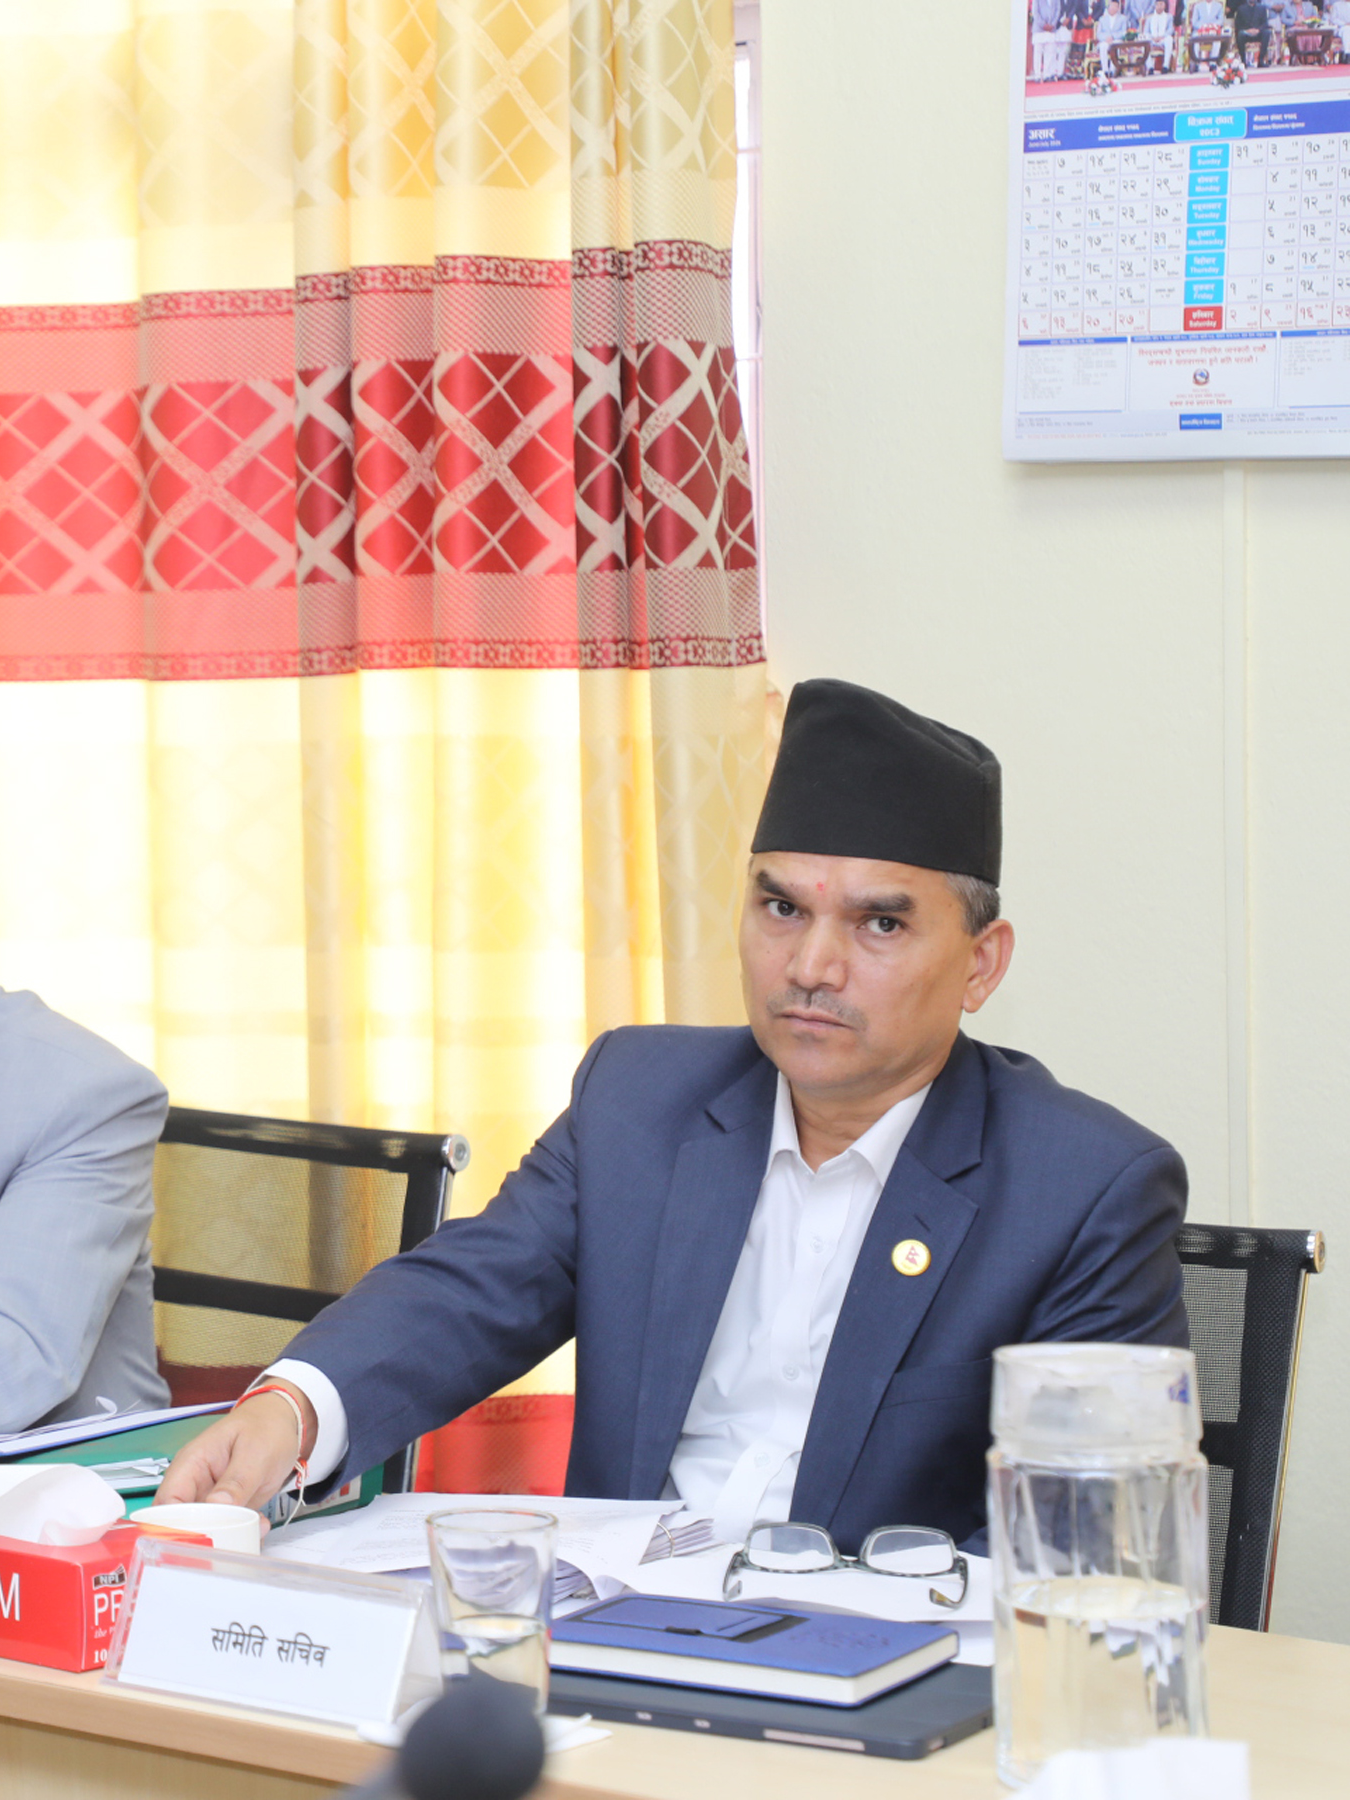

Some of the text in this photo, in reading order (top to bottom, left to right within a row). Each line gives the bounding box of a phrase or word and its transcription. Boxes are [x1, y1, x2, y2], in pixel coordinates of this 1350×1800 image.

[1236, 146, 1248, 159] ३१
[1306, 142, 1320, 154] १०
[1124, 153, 1136, 166] २१
[1157, 151, 1172, 163] २८
[1270, 171, 1279, 182] ४
[1305, 169, 1317, 181] ११
[1122, 180, 1136, 192] २२
[1304, 196, 1318, 209] १२
[1303, 224, 1315, 238] १३
[1302, 252, 1318, 264] १४
[1230, 282, 1236, 295] १
[1193, 292, 1214, 300] Friday
[1189, 320, 1216, 328] Saturday
[211, 1621, 331, 1668] समिति सचिव
